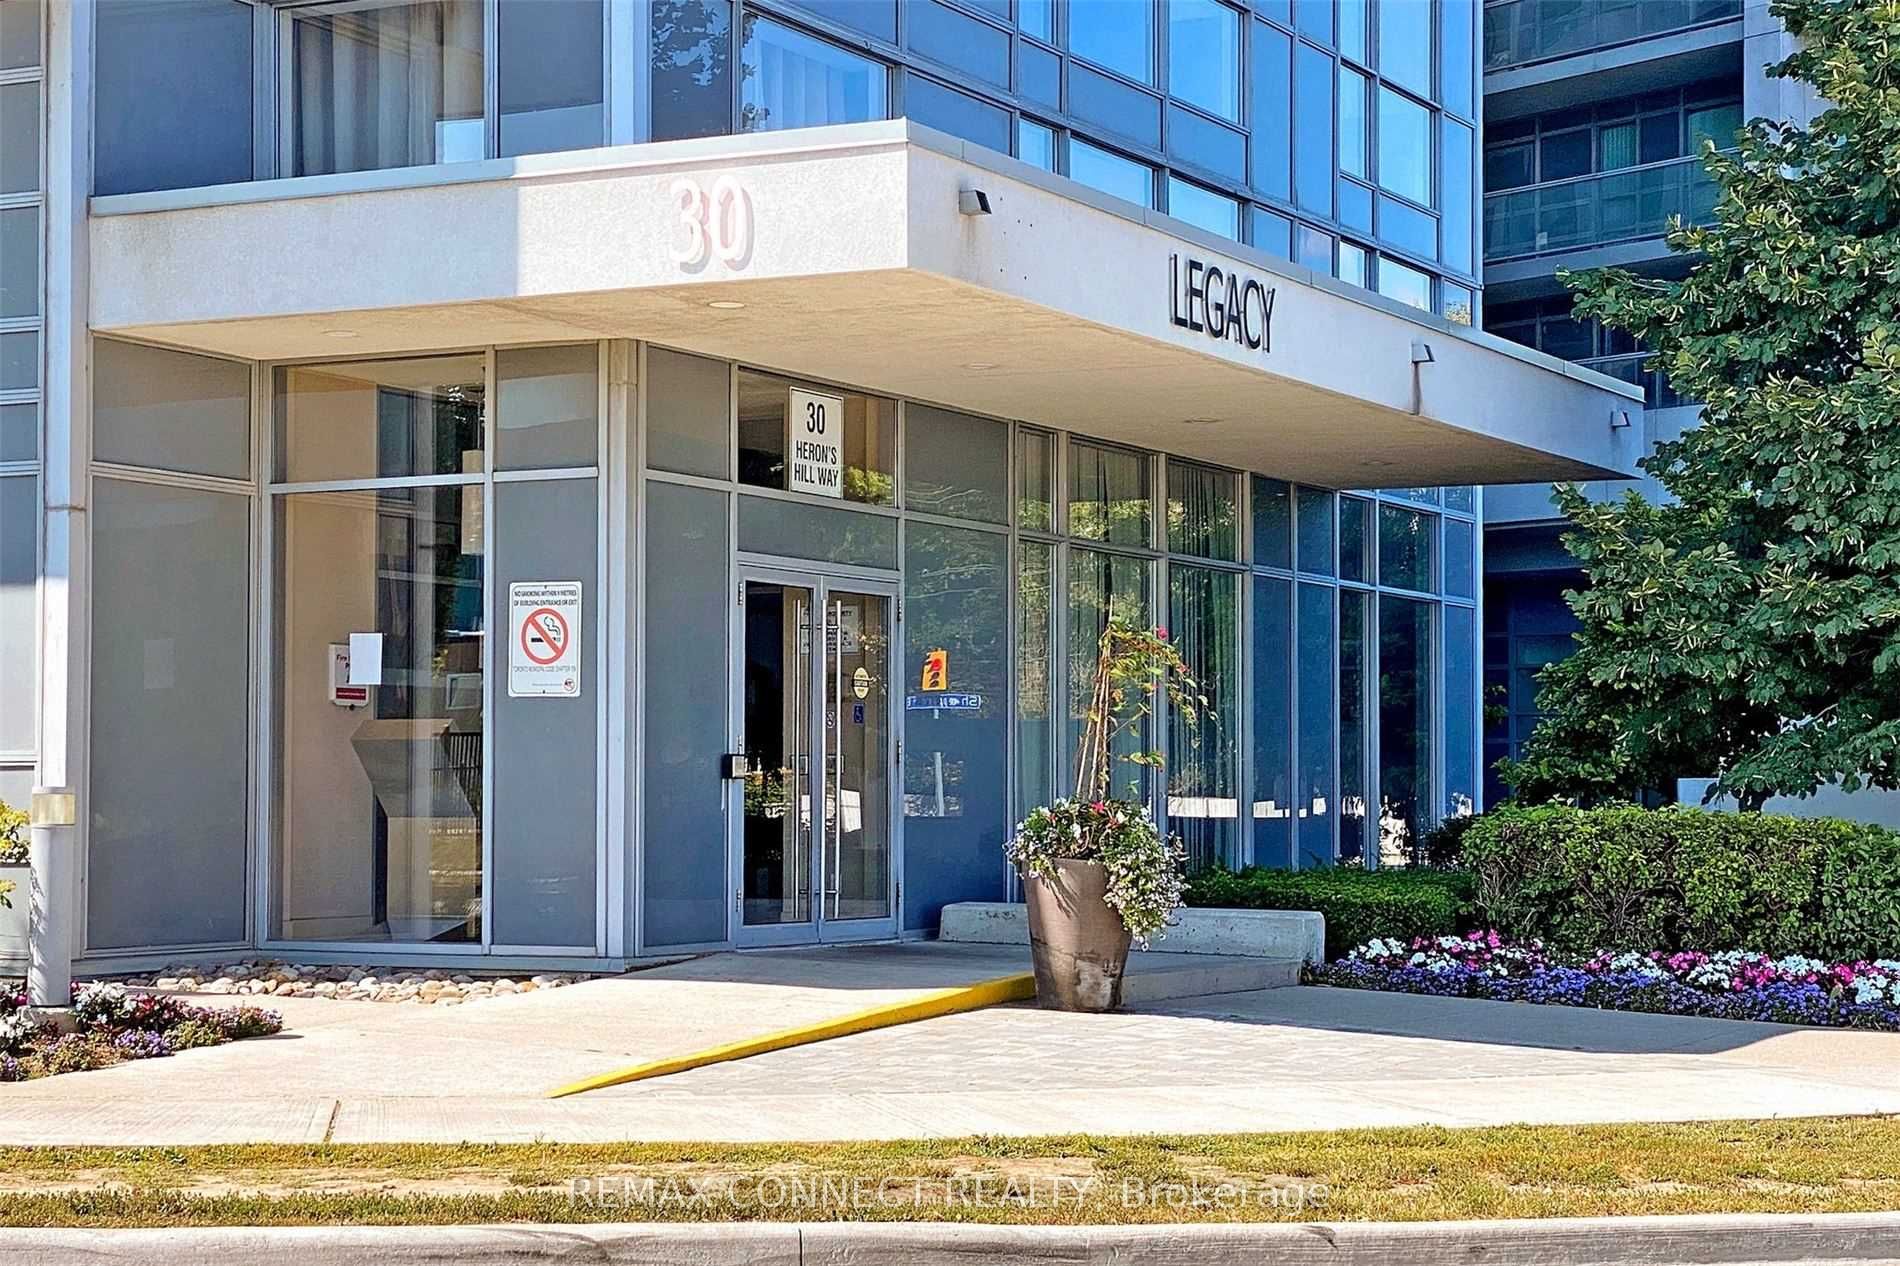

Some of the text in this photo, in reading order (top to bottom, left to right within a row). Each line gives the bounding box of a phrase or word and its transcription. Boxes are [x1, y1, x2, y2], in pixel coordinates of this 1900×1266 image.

[669, 177, 754, 274] 30
[1169, 253, 1276, 354] LEGACY
[806, 402, 825, 434] 30
[795, 440, 837, 464] HERON'S
[794, 463, 839, 487] HILL WAY
